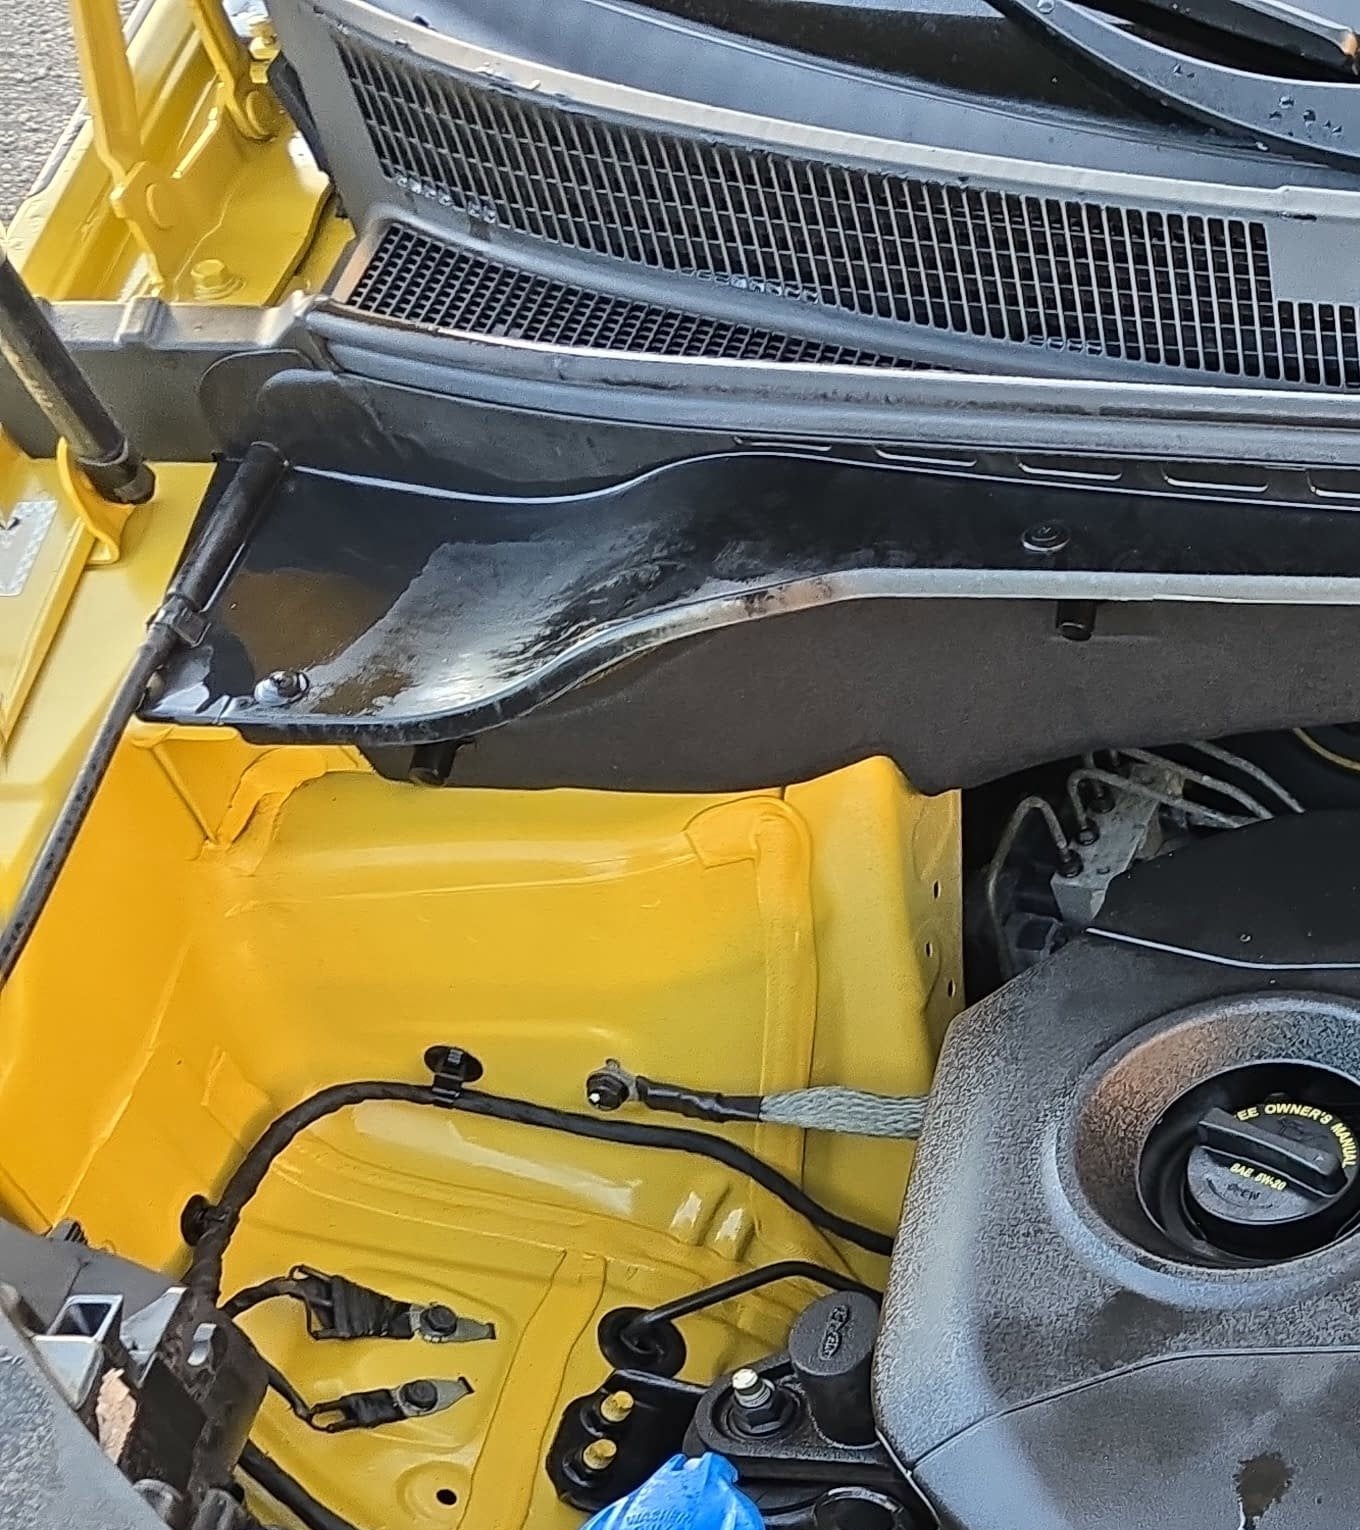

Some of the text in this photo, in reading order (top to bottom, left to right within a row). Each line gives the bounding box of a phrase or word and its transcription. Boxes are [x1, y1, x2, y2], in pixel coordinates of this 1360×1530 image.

[1234, 1102, 1358, 1169] EE OWNER'S MANUAL
